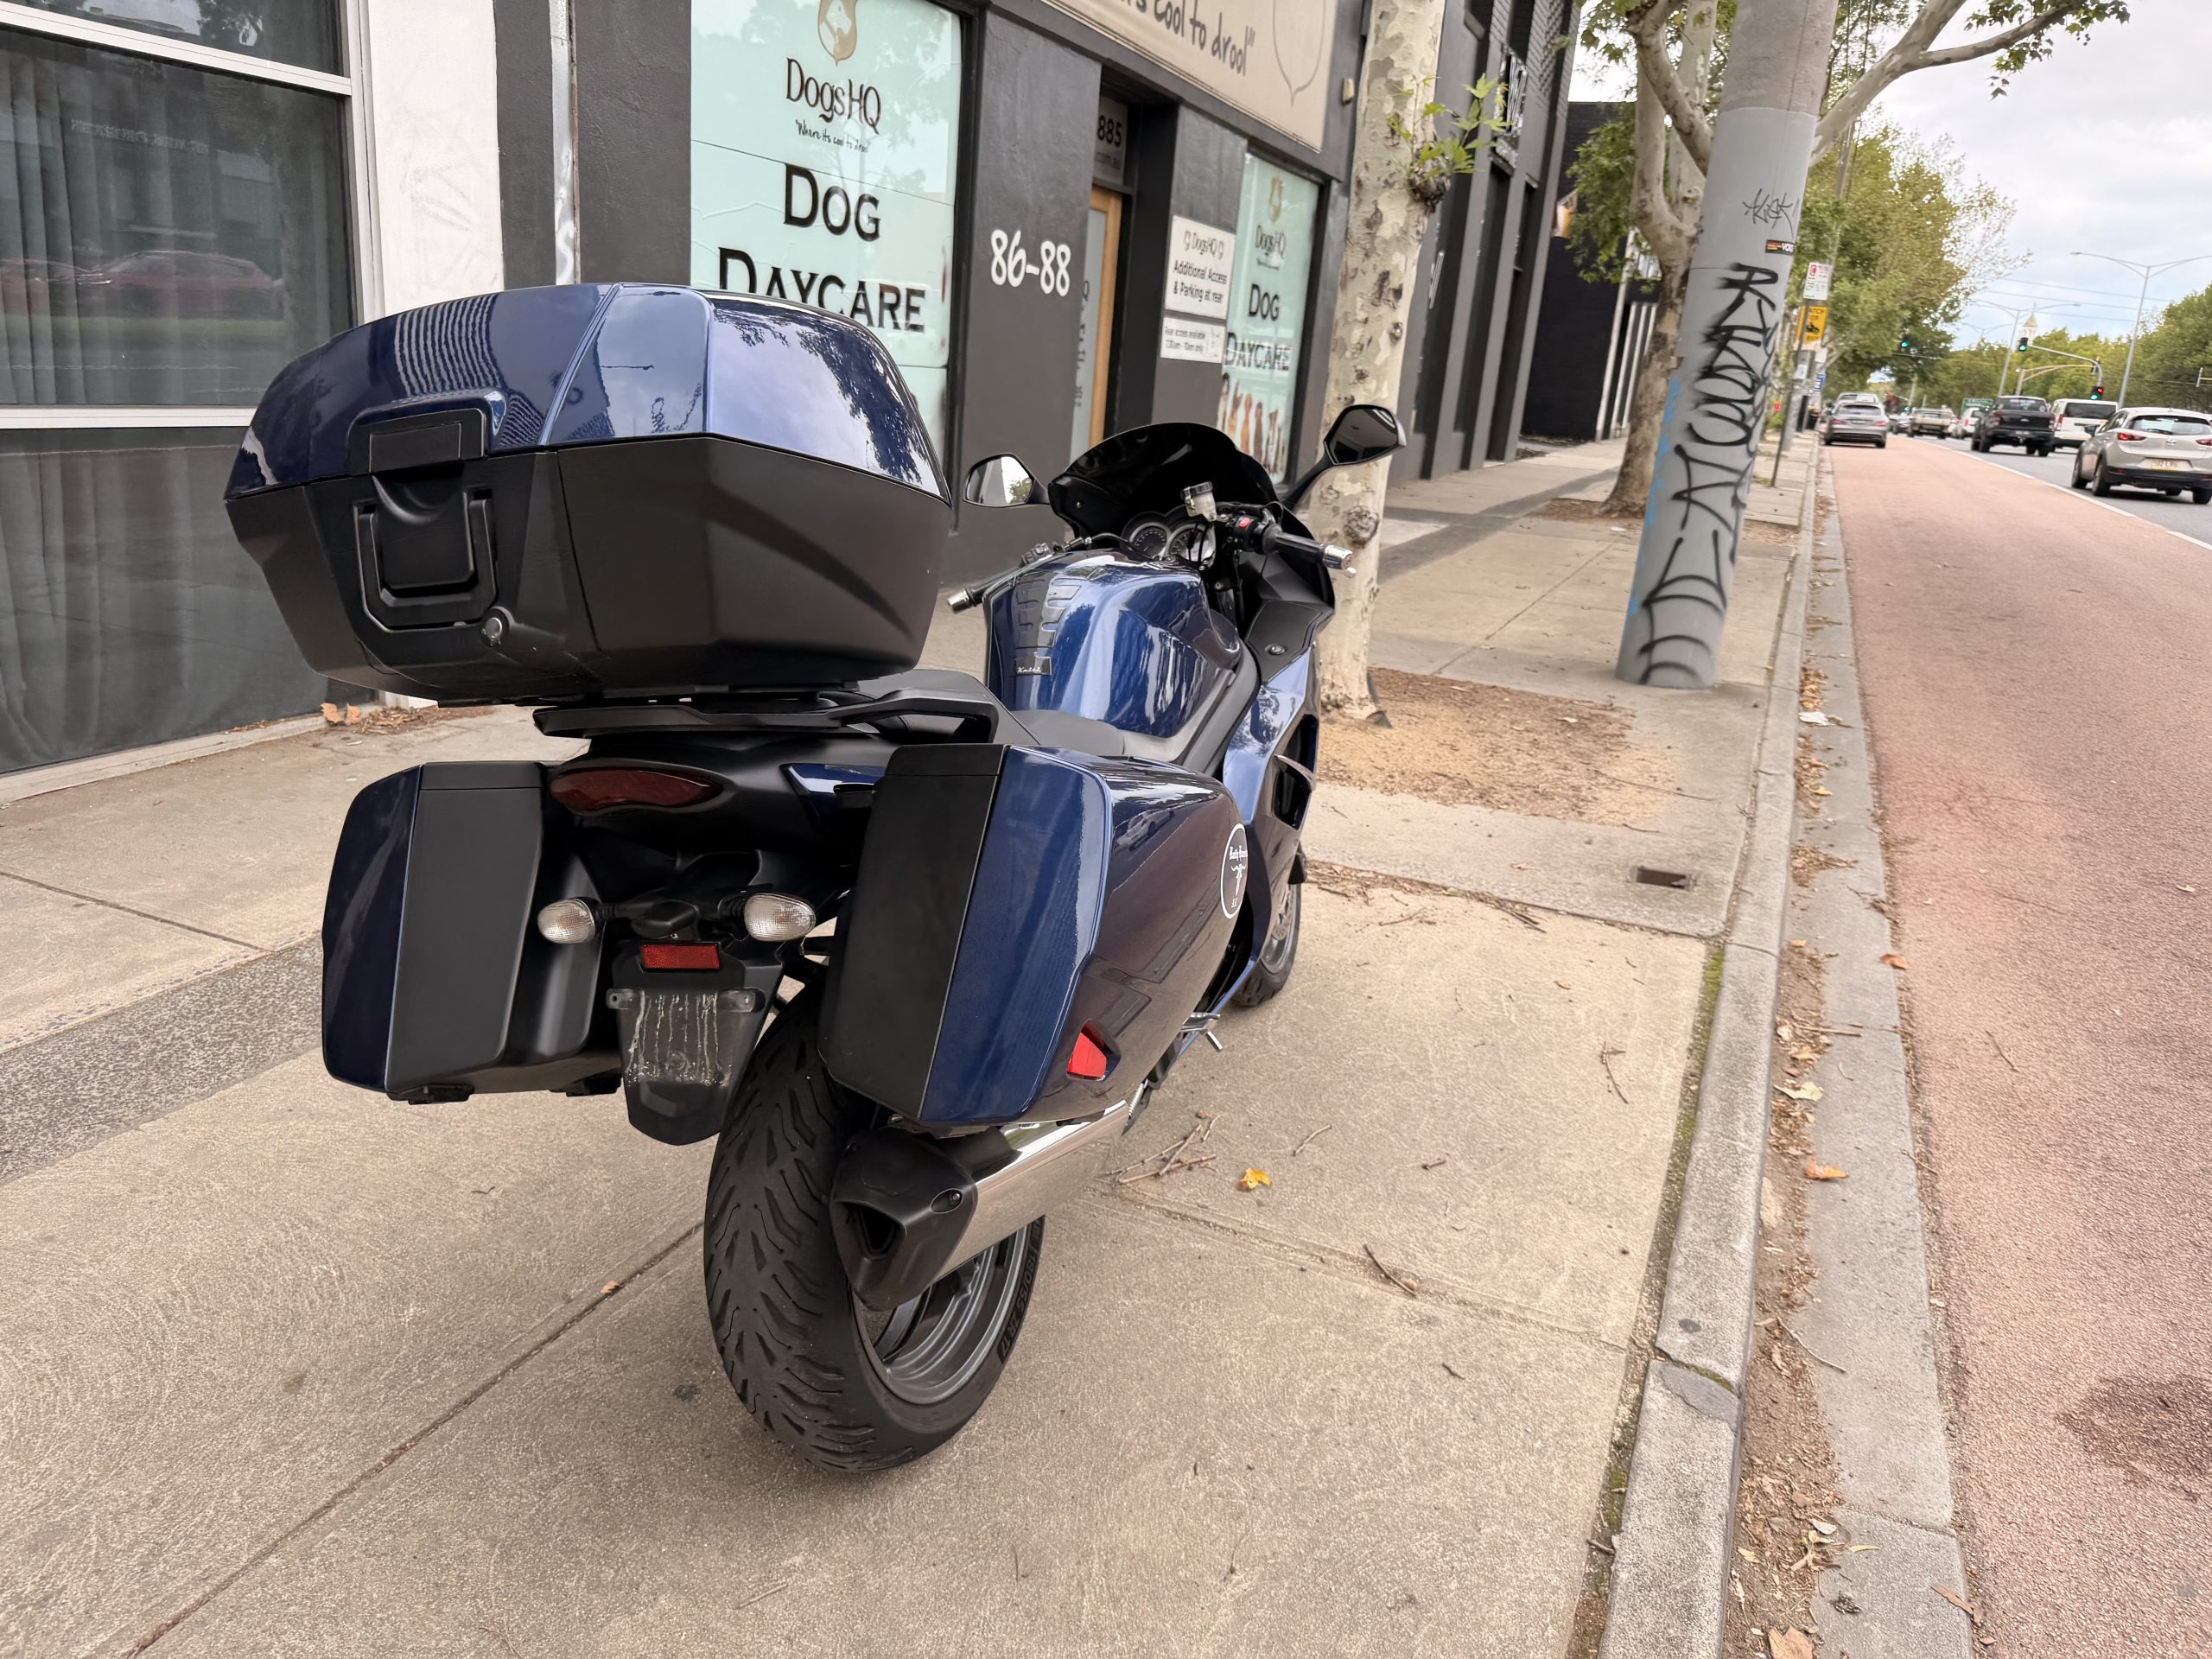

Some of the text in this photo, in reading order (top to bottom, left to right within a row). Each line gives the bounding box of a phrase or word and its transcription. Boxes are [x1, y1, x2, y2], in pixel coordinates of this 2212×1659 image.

[1189, 0, 1207, 51] to
[1096, 114, 1122, 148] 885
[989, 229, 1071, 297] 86-88
